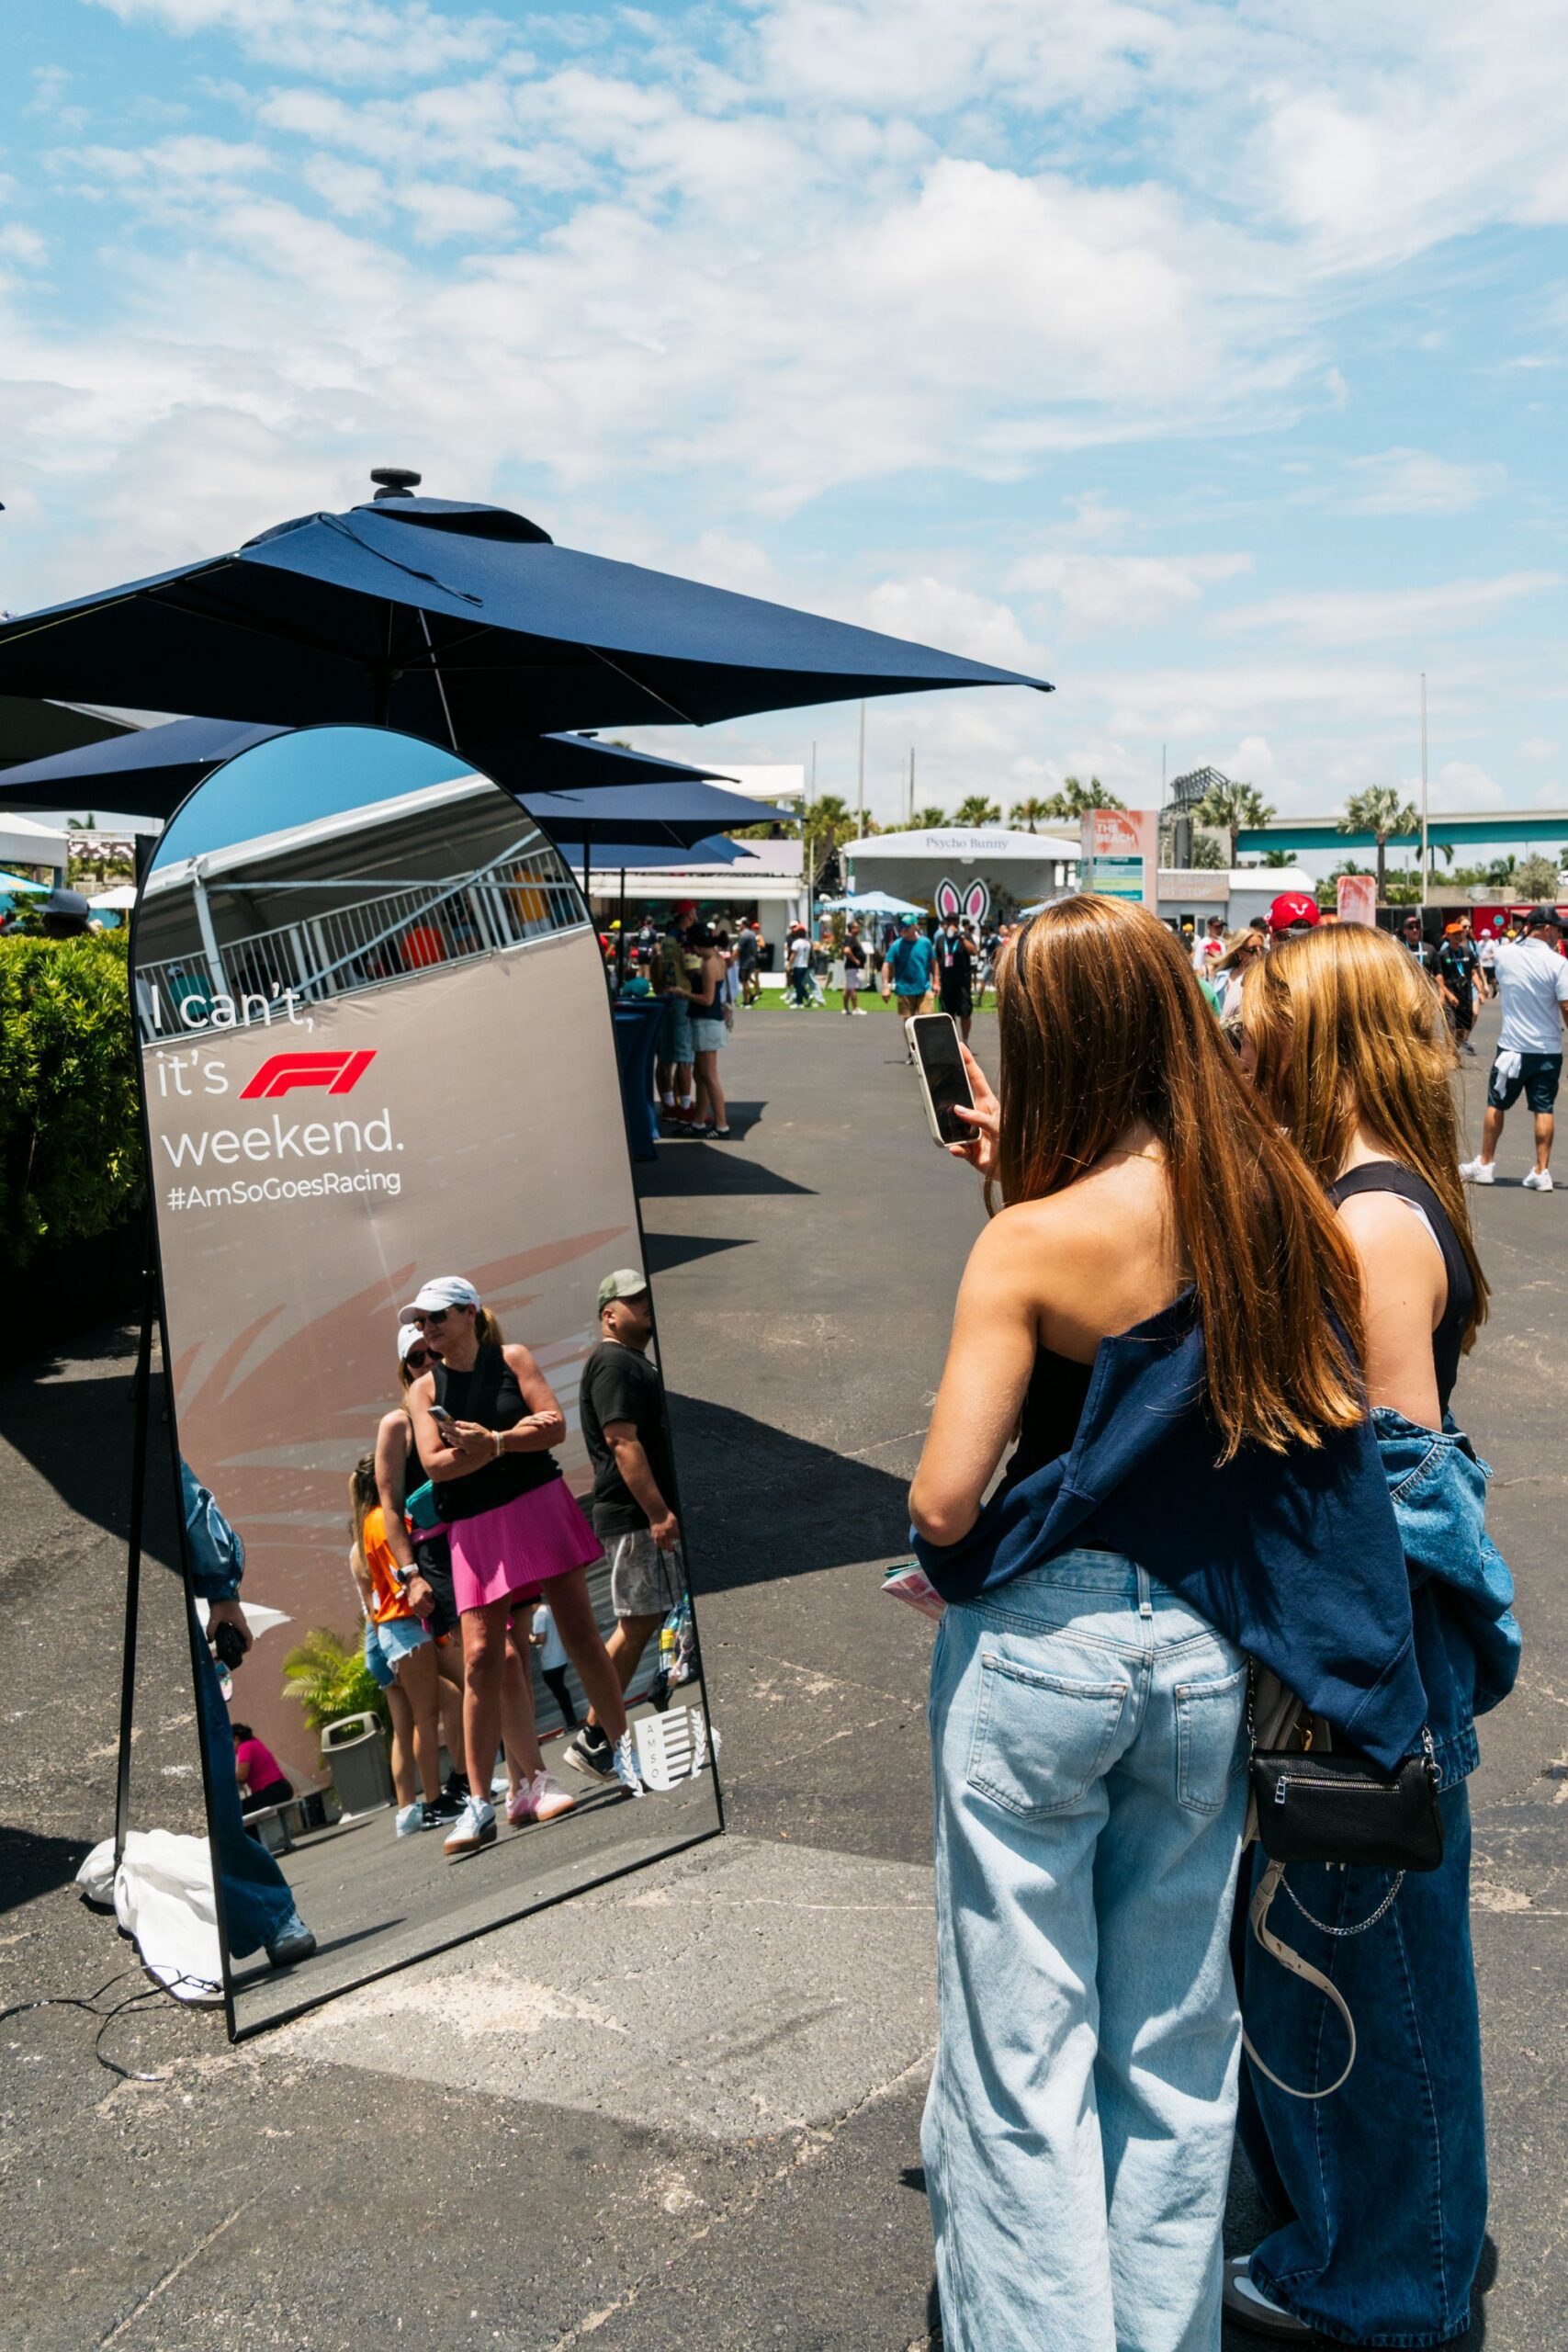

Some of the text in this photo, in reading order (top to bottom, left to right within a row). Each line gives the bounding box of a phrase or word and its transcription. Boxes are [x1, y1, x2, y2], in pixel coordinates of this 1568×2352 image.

[926, 837, 1008, 850] Psycho Bunny
[1097, 824, 1118, 833] THE
[151, 982, 314, 1034] I can't,
[155, 1049, 230, 1097] it's
[160, 1108, 405, 1169] weekend.
[166, 1169, 401, 1211] #AmSoGoesRacing
